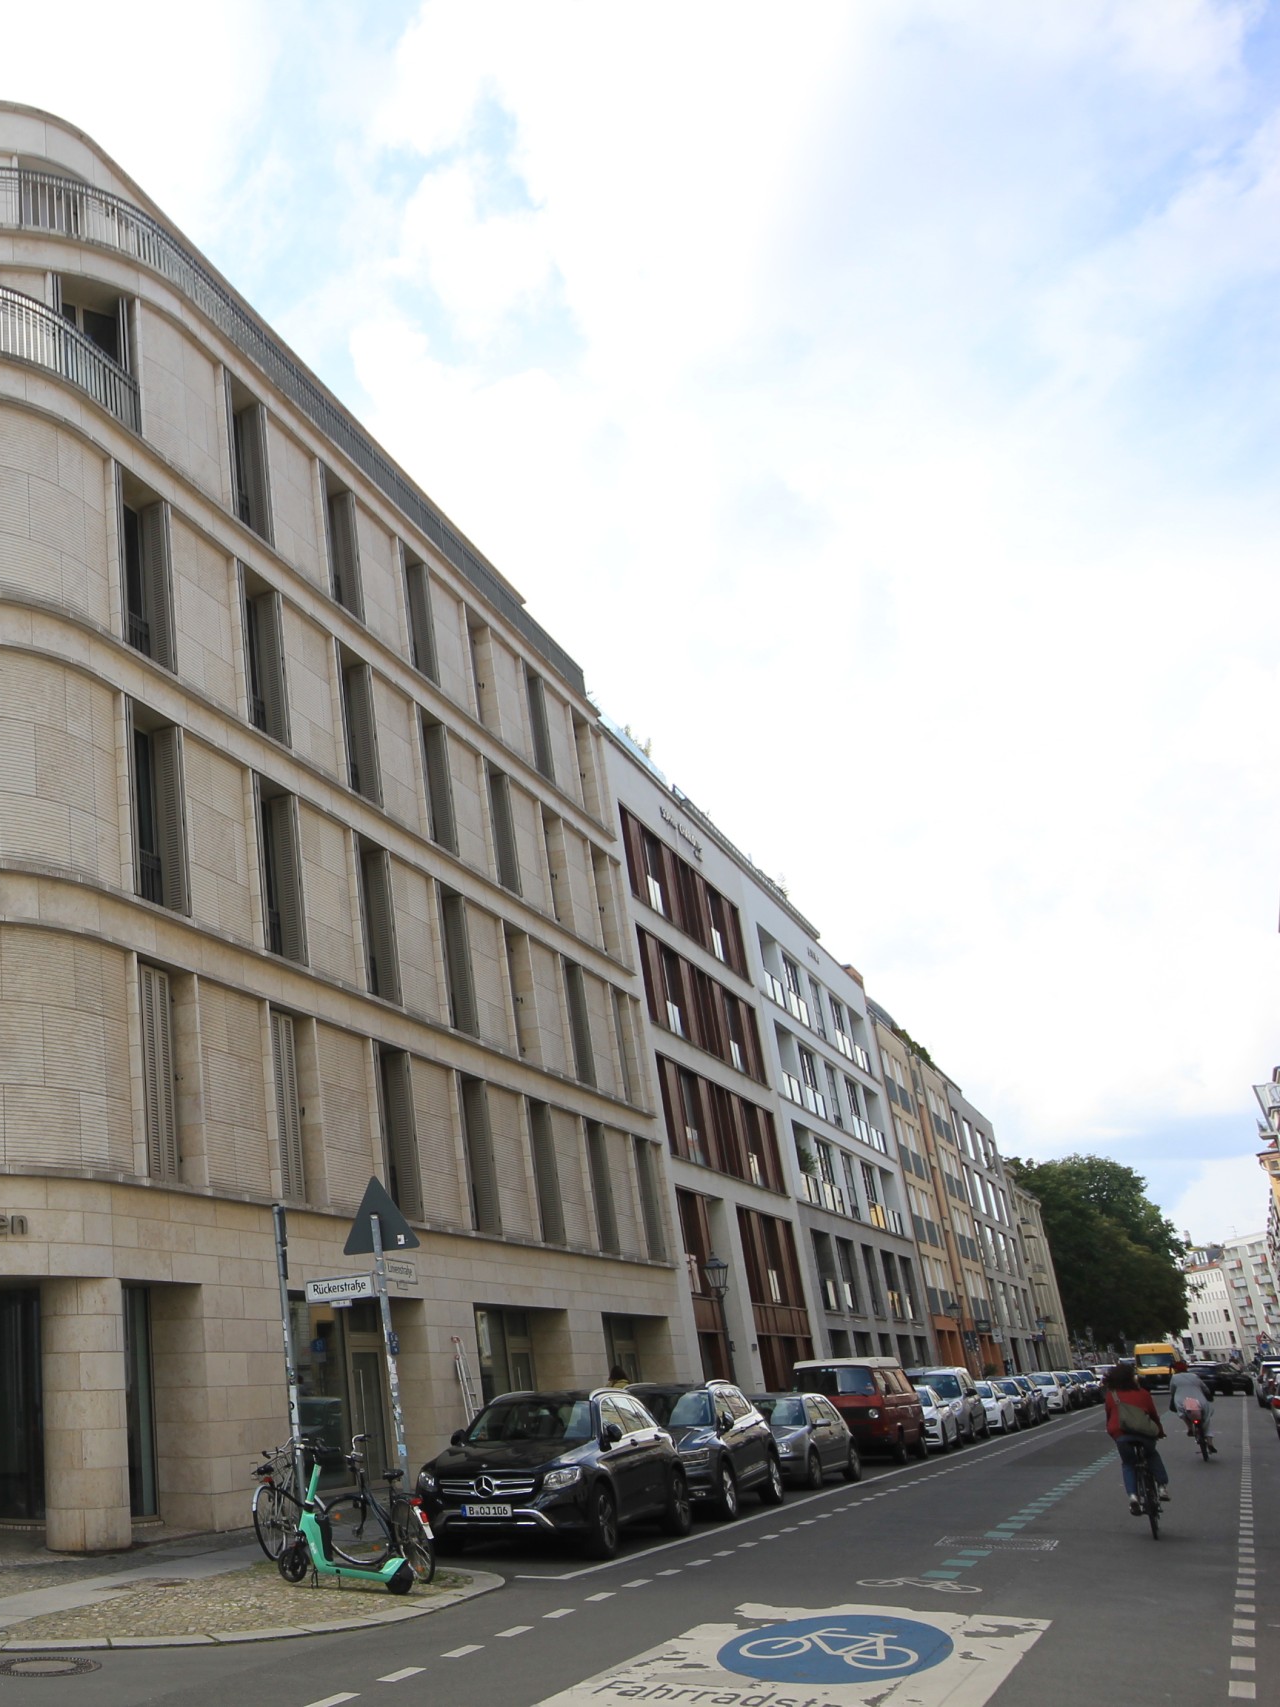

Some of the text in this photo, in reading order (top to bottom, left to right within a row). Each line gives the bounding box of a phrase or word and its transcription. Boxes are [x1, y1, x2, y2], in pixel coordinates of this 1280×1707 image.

[313, 1280, 367, 1295] Rückerstraße
[468, 1506, 475, 1516] B
[492, 1506, 508, 1516] 106
